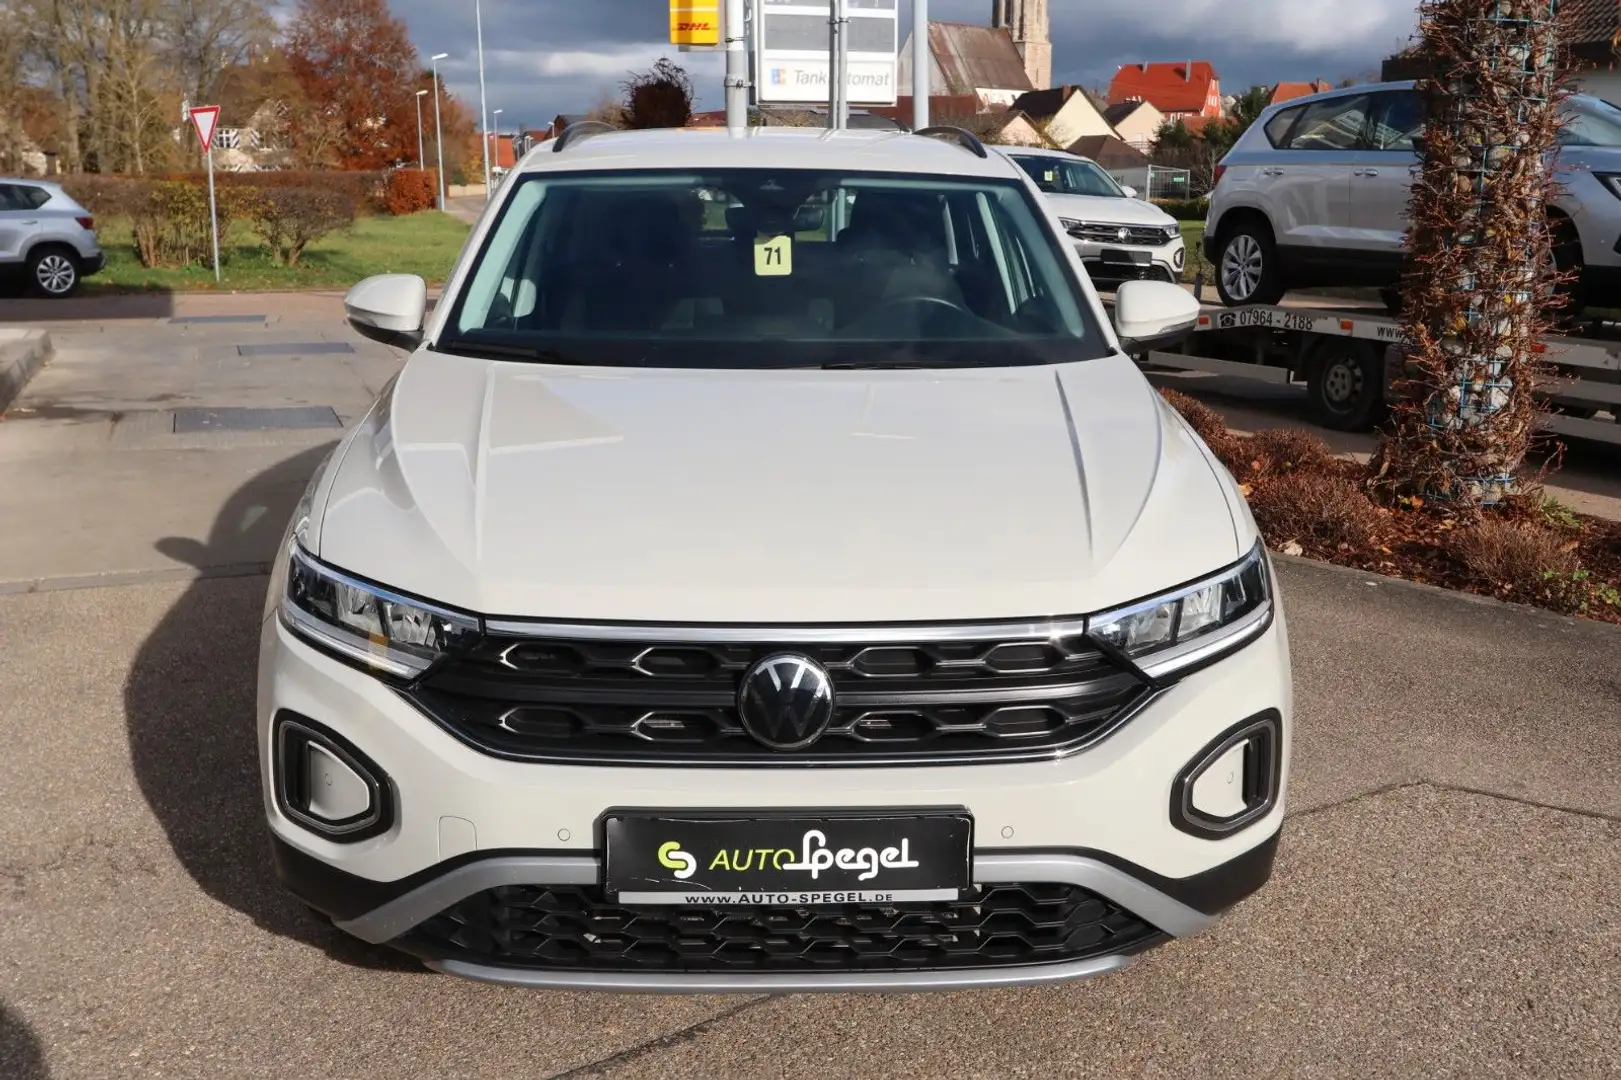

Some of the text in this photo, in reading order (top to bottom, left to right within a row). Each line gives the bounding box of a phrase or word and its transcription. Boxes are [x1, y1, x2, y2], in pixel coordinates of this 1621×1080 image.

[677, 22, 710, 31] DHL
[764, 247, 782, 265] 71
[1240, 310, 1273, 326] 07964
[1284, 312, 1313, 331] 2188
